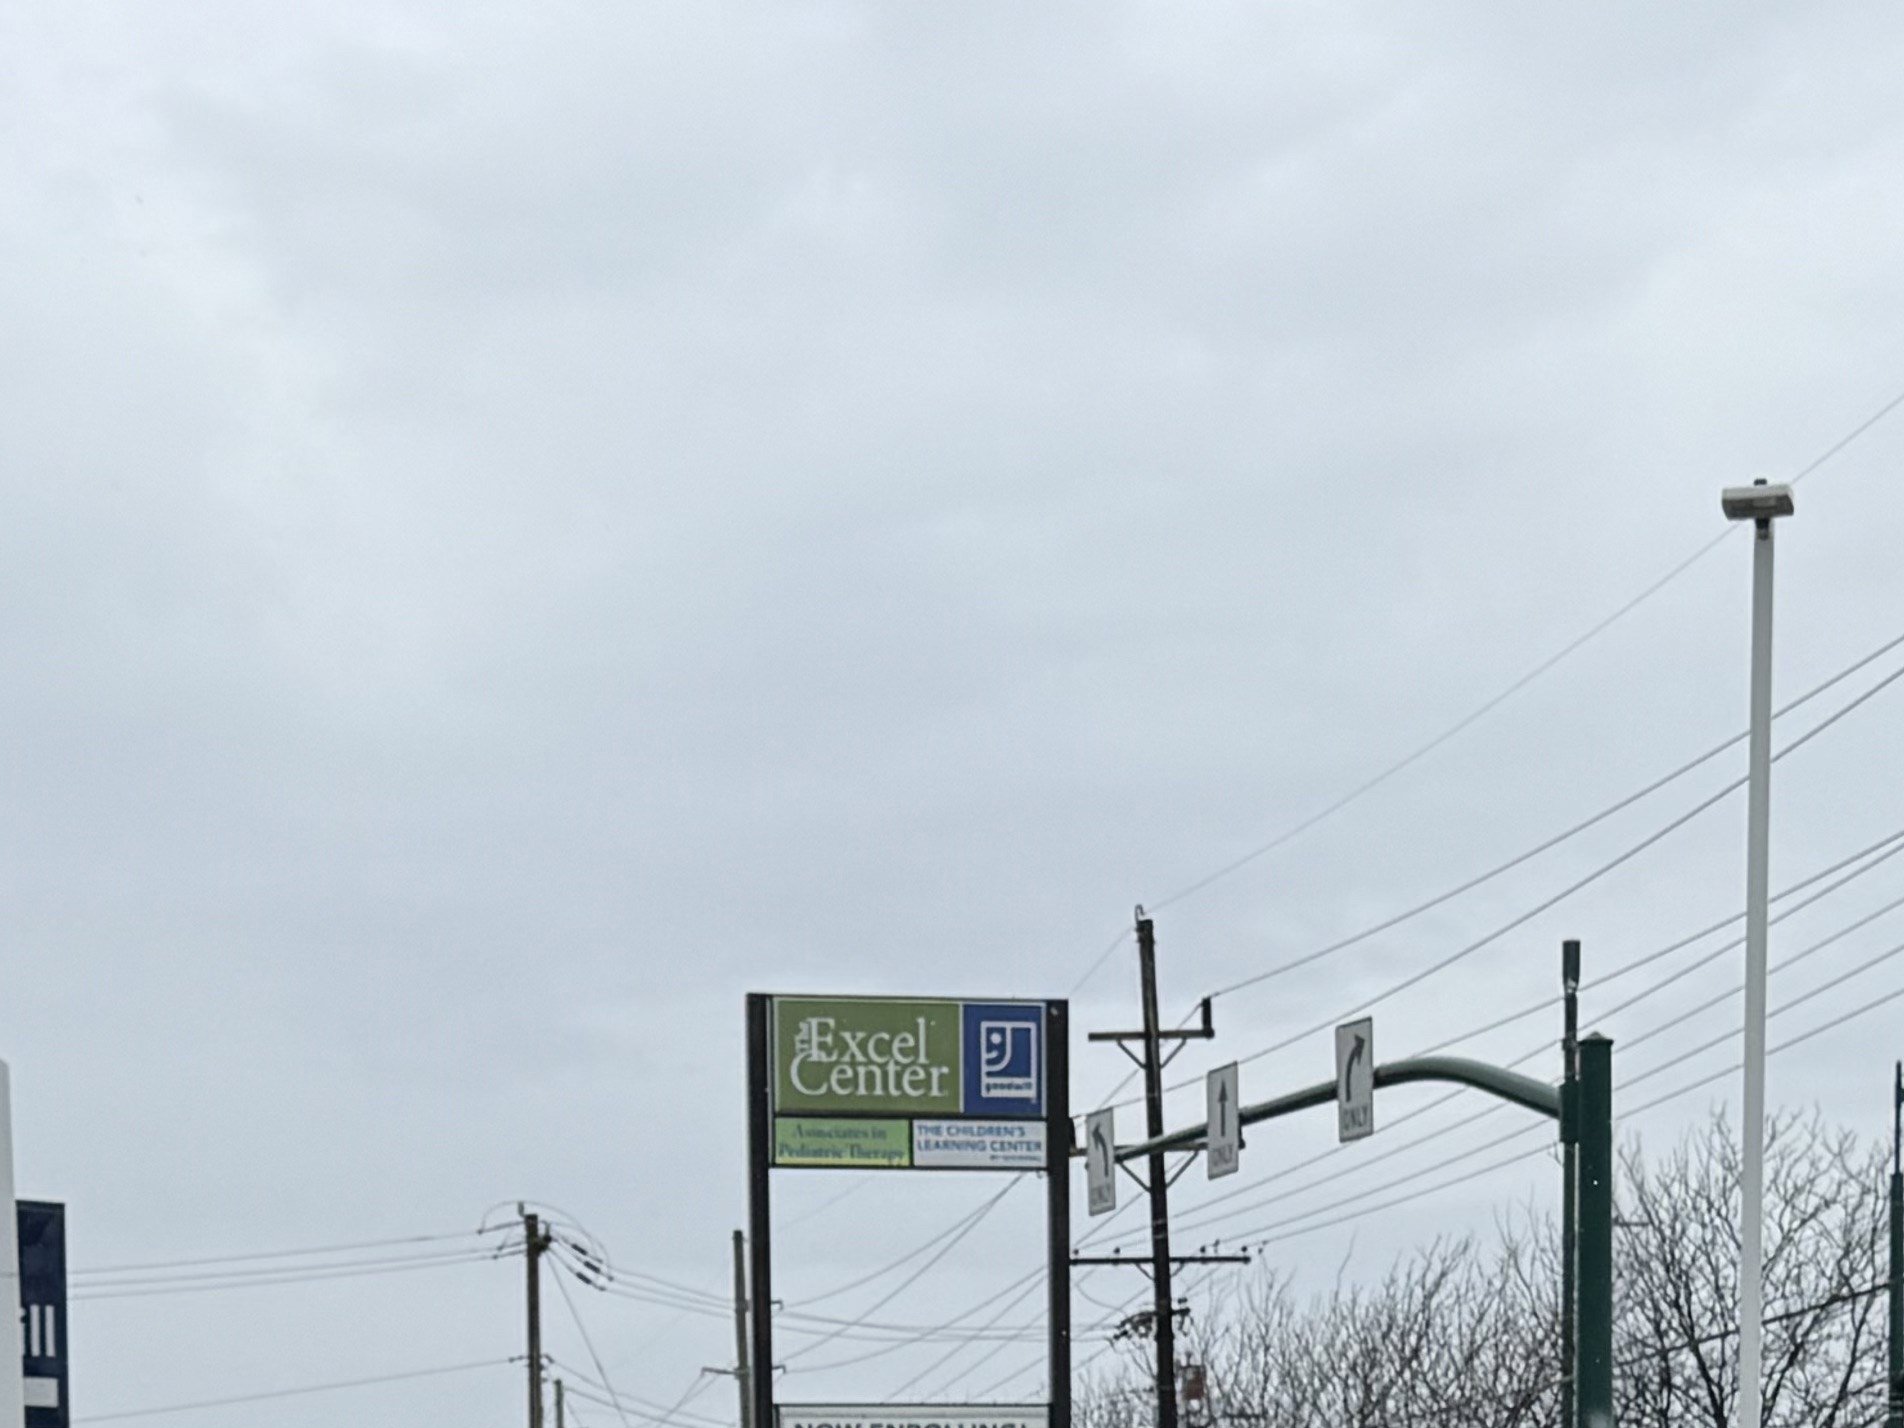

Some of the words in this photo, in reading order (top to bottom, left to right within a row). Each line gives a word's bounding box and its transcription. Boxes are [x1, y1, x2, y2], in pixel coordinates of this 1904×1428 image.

[806, 1017, 930, 1064] Excel
[790, 1049, 950, 1097] Center
[917, 1125, 942, 1136] THE
[946, 1125, 1026, 1138] CHILDREN'S
[917, 1140, 987, 1152] LEARNING
[990, 1141, 1042, 1153] CENTER
